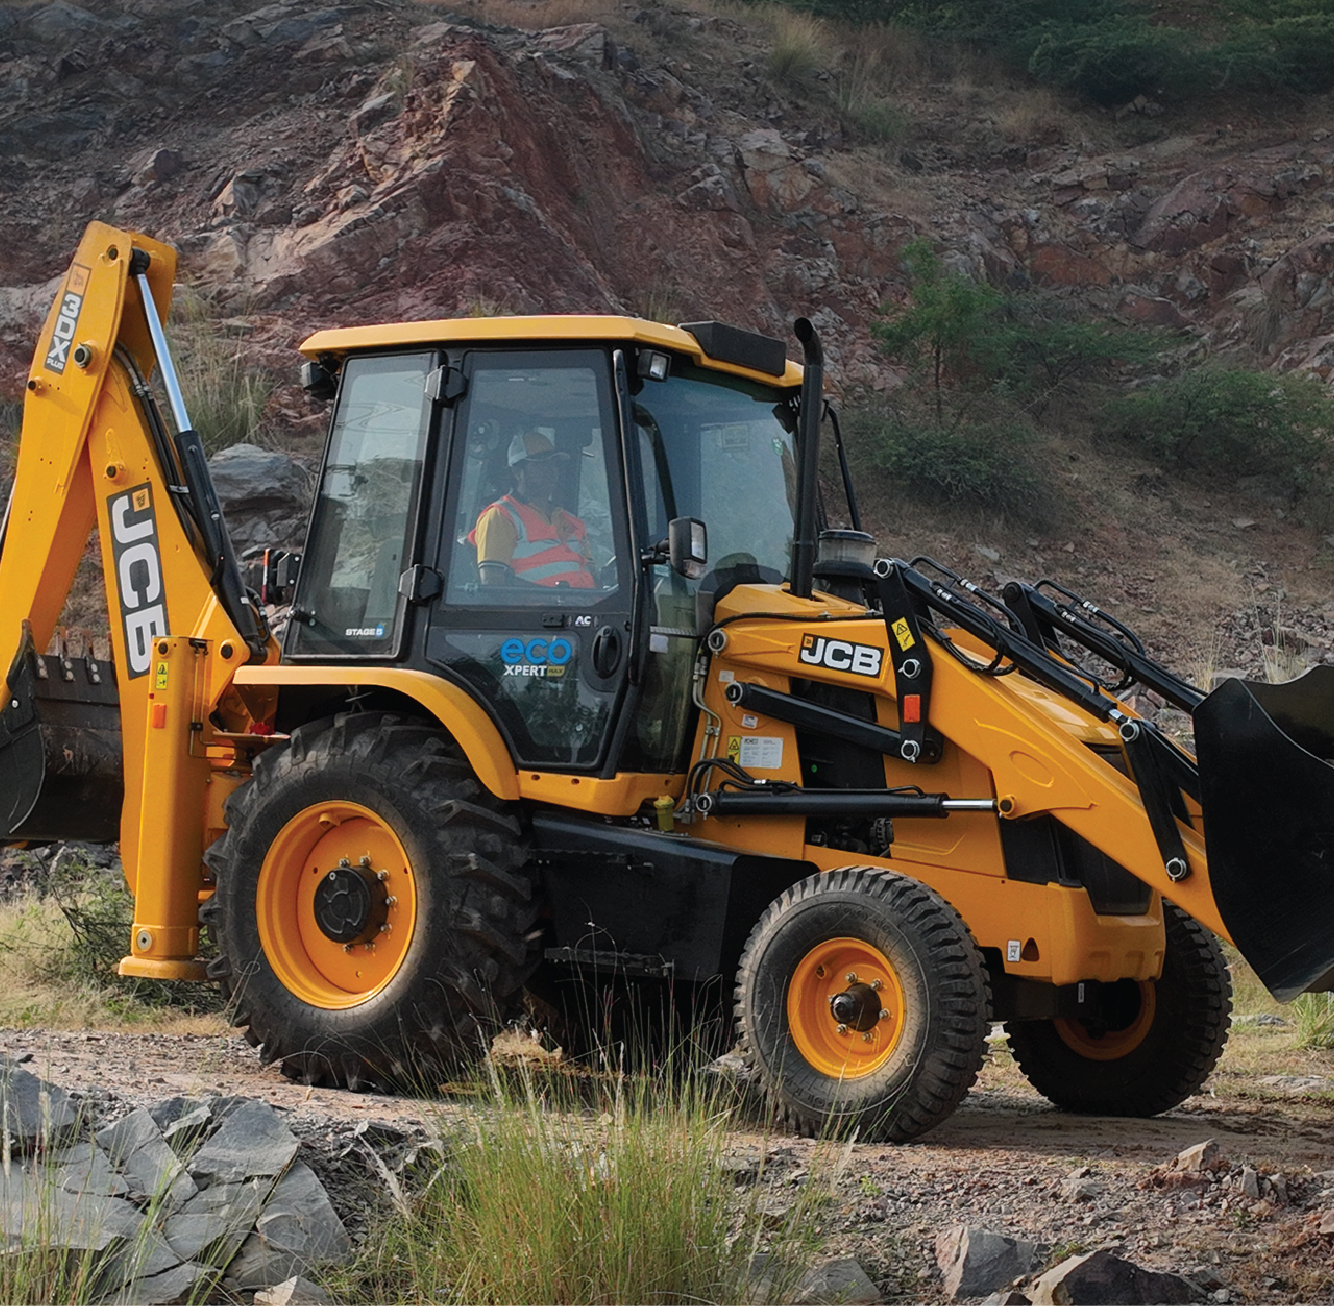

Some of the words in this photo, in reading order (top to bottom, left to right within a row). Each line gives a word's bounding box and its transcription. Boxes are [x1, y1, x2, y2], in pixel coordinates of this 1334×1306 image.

[48, 293, 82, 363] 3DX
[111, 494, 166, 673] JCB
[575, 615, 592, 625] AC
[500, 638, 572, 665] eco
[800, 638, 881, 675] JCB
[503, 665, 547, 677] XPERT
